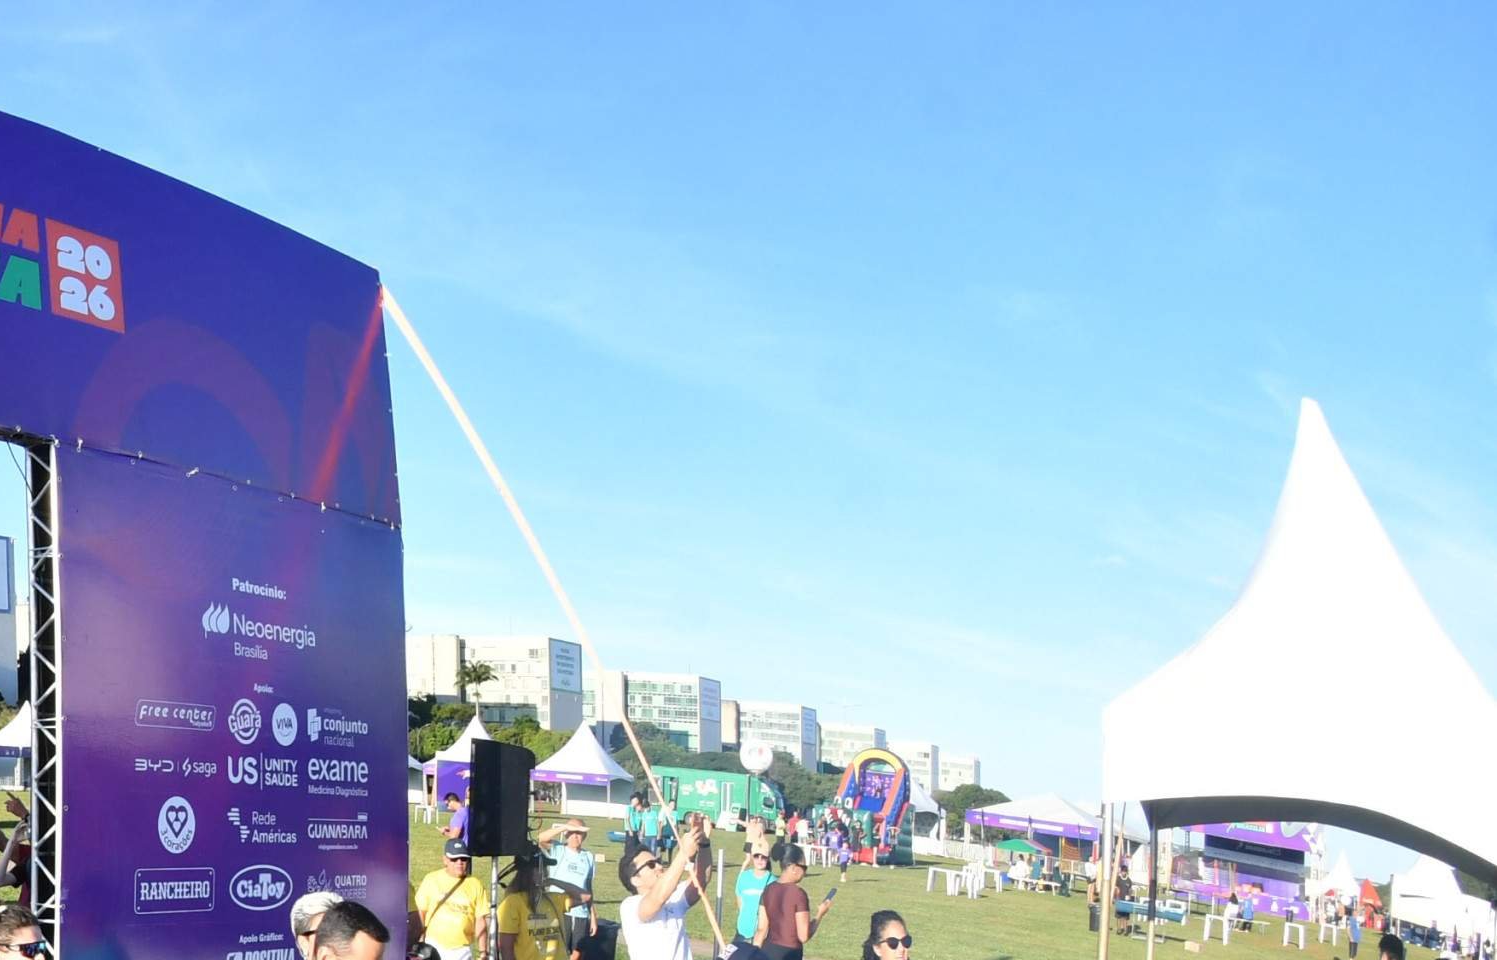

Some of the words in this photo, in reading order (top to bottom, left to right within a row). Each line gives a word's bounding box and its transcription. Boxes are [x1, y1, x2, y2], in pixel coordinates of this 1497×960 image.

[55, 235, 113, 281] 20
[58, 275, 116, 321] 26
[231, 577, 287, 601] Patrocínio:
[233, 612, 316, 650] Neoenergia
[234, 642, 269, 660] Brasília
[227, 710, 262, 734] Guará
[276, 717, 293, 730] VIVA
[323, 716, 369, 735] conjunto
[323, 736, 355, 748] nacional
[134, 758, 175, 772] BYD
[192, 761, 217, 778] saga
[227, 755, 259, 785] US
[264, 758, 299, 773] UNITY
[307, 758, 369, 783] exame
[264, 772, 299, 787] SAÚDE
[307, 785, 335, 796] Medicina
[252, 810, 277, 825] Rede
[251, 827, 298, 844] Américas
[307, 823, 369, 840] GUANABARA
[139, 879, 211, 901] RANCHEIRO
[235, 872, 286, 901] CiaToy
[334, 874, 368, 888] QUATRO
